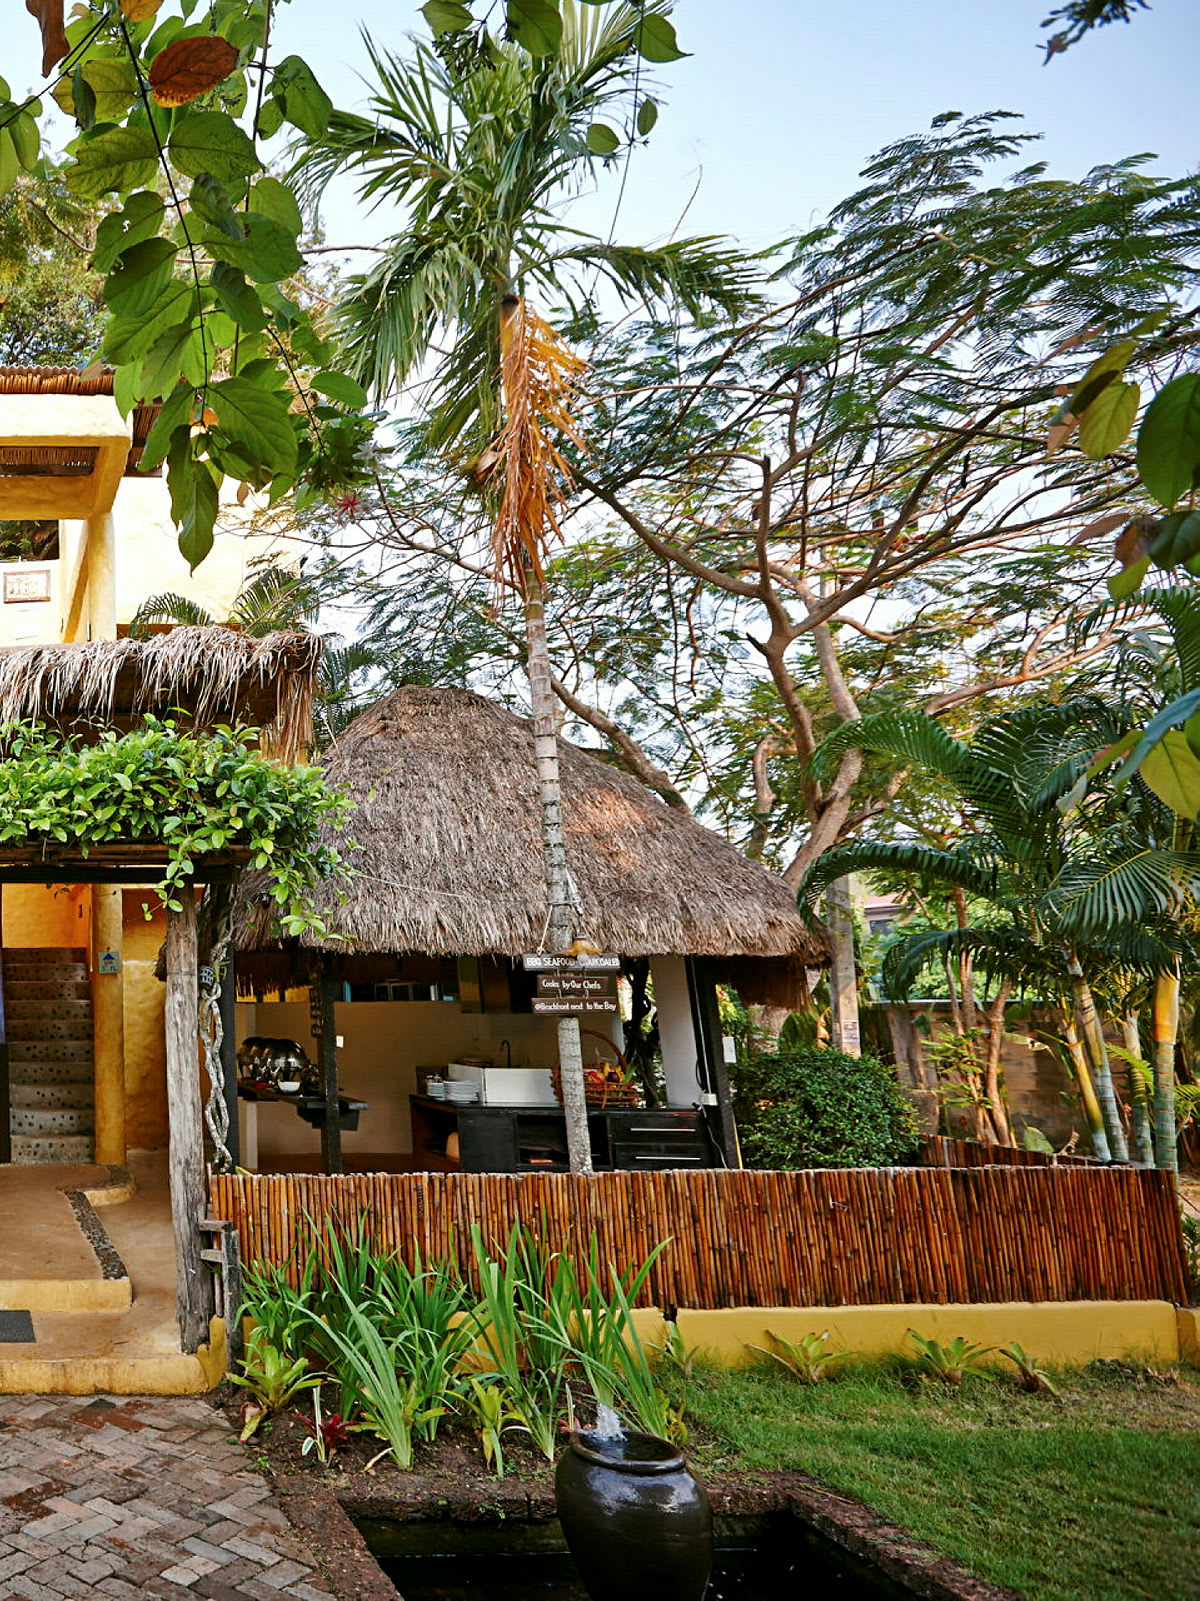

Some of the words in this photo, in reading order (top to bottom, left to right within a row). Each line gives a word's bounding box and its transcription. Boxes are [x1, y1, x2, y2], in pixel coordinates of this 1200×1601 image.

[526, 957, 542, 967] BBQ
[543, 957, 575, 967] SEAFOOD
[604, 1001, 617, 1011] Bay
